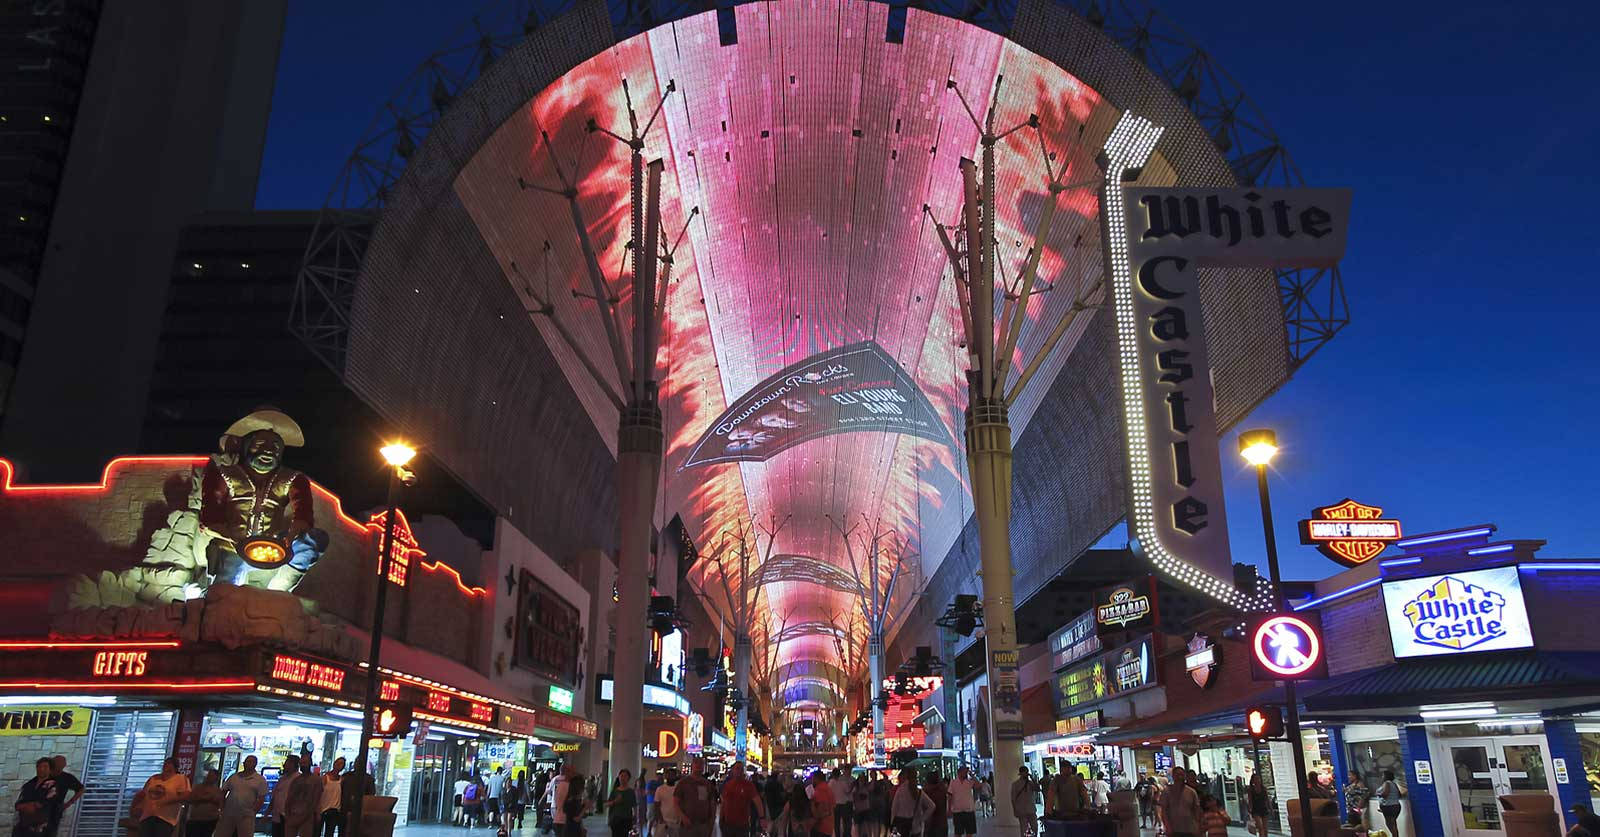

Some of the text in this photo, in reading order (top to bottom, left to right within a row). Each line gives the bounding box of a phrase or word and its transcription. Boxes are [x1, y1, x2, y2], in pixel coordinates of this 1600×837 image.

[1138, 192, 1333, 247] White
[831, 391, 858, 405] ELI
[854, 388, 907, 403] YOUNG
[1137, 255, 1208, 537] Castle
[716, 385, 791, 436] Downtown
[862, 401, 903, 415] BAND
[1331, 504, 1374, 519] MOTOR
[1313, 523, 1396, 537] HARLEY-DAVIDSON
[1336, 541, 1379, 559] CYCLES
[1416, 597, 1494, 621] White
[1414, 616, 1502, 641] Castle
[94, 652, 147, 675] GIFTS
[273, 656, 307, 683] INDIAN
[553, 743, 580, 752] LIQUOR
[643, 730, 679, 758] the D
[1048, 743, 1092, 756] LIQUOR
